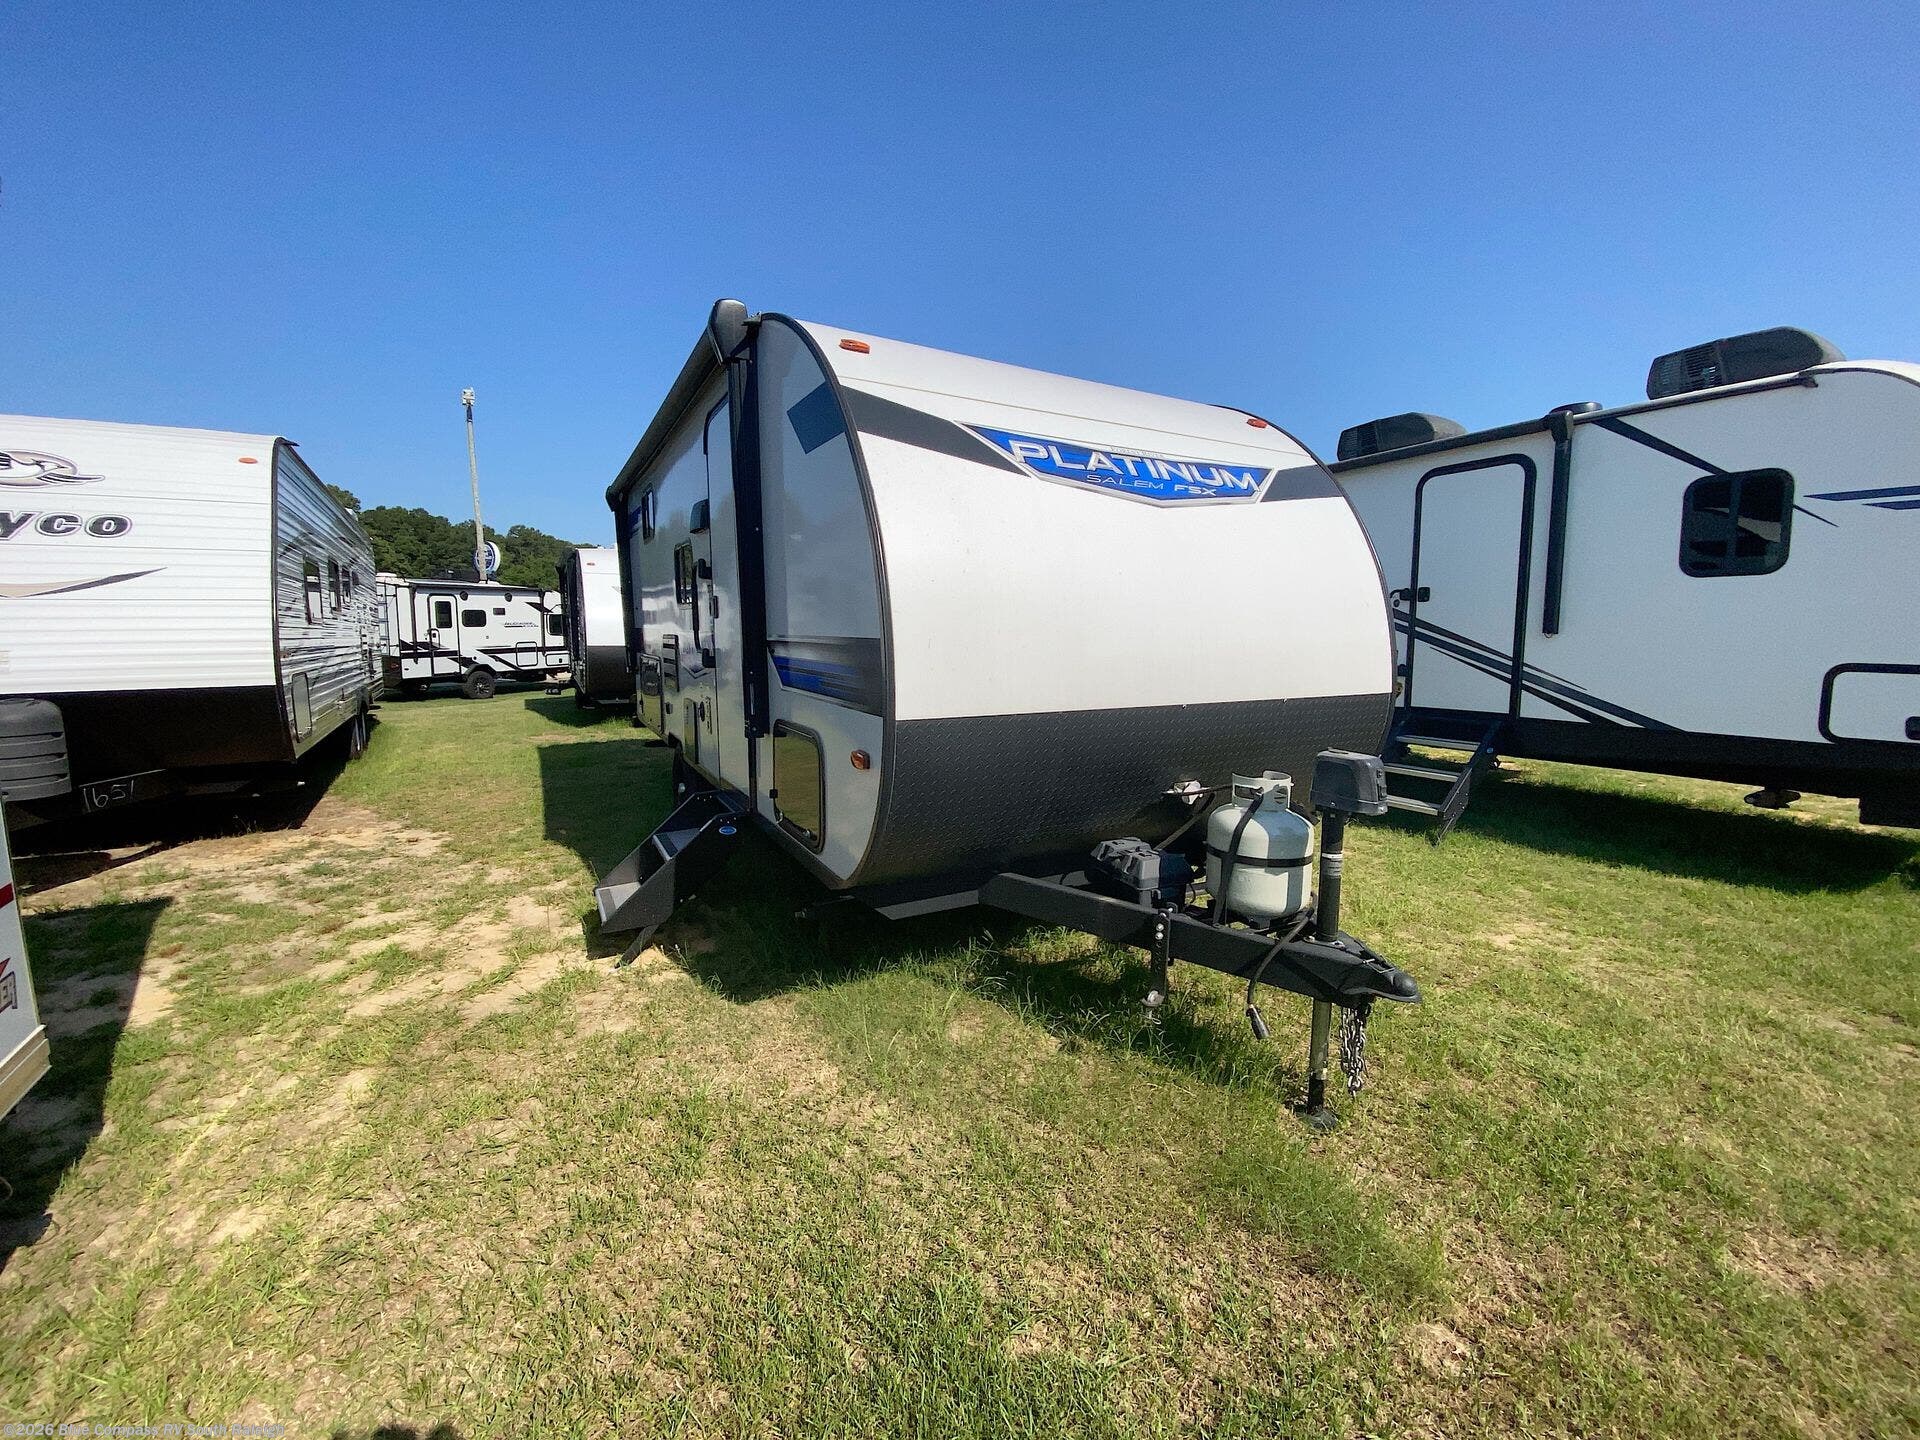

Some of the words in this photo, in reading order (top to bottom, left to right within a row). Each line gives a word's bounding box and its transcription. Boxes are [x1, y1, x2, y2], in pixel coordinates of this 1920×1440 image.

[1008, 439, 1262, 492] PLATINUM
[1086, 474, 1164, 490] SALEM
[1173, 484, 1218, 497] FSX
